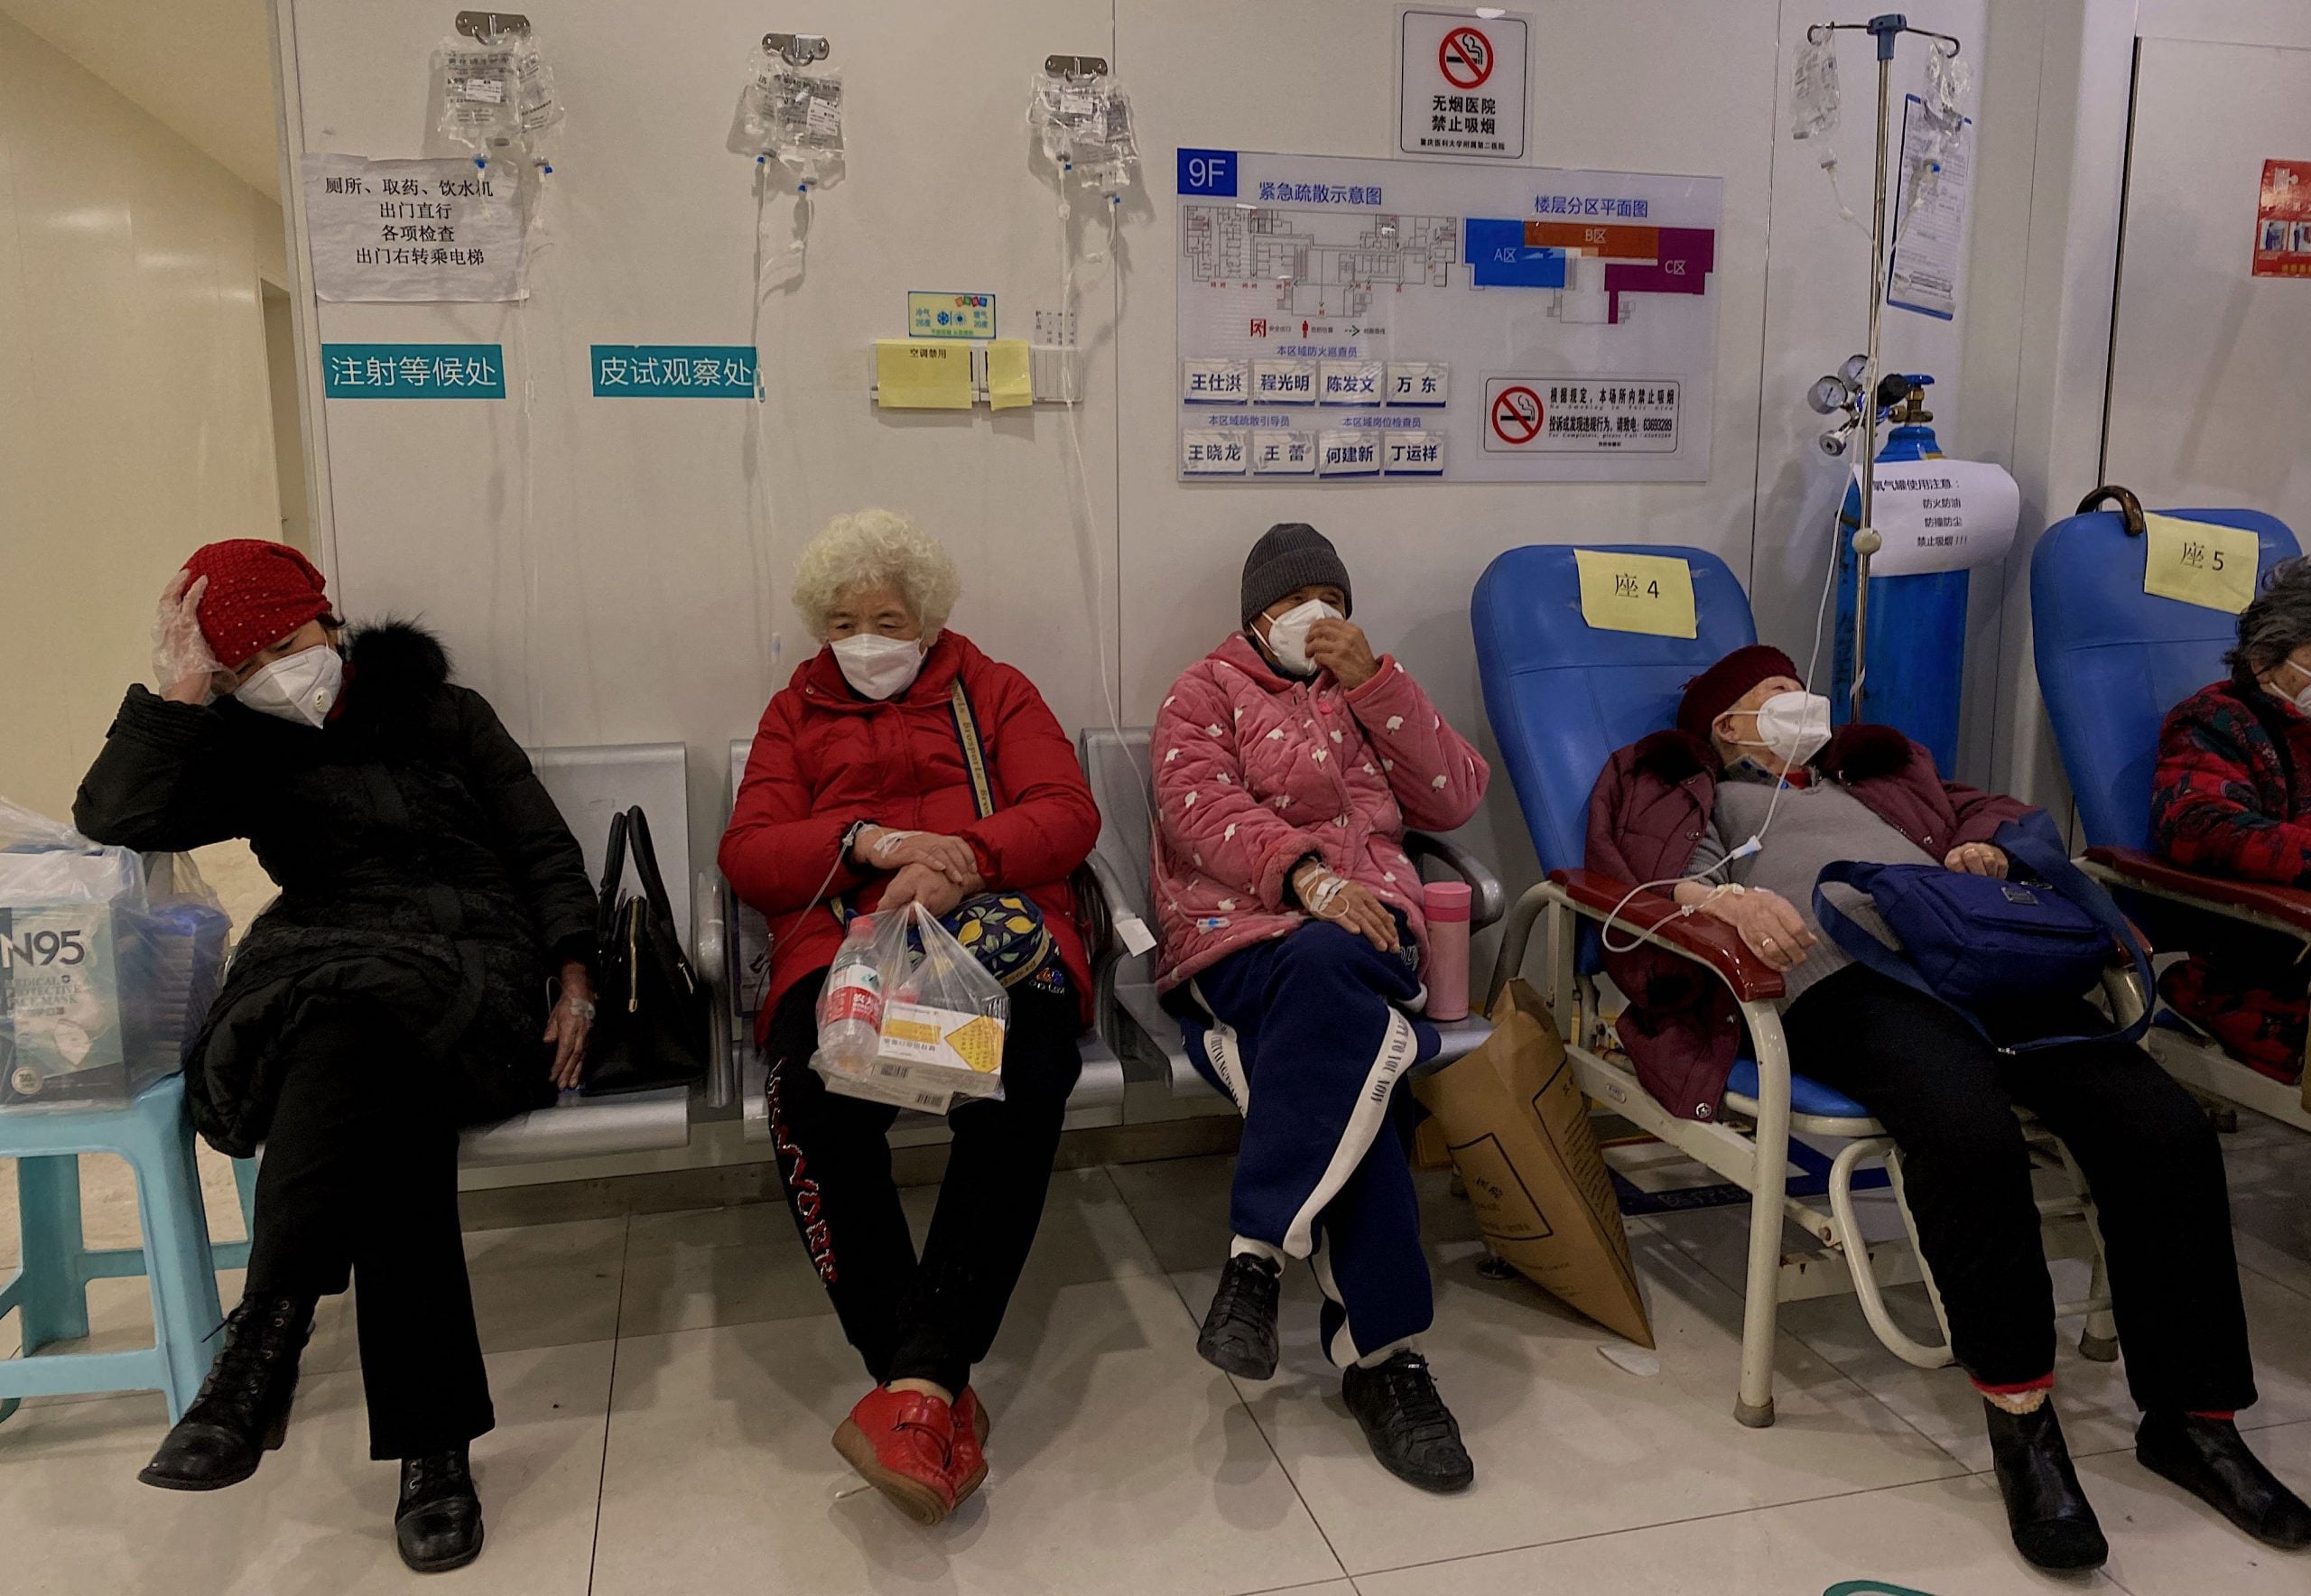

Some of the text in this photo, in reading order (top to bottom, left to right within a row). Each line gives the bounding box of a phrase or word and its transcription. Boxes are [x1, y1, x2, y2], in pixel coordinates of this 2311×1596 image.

[1432, 95, 1496, 115] 无烟医院
[1432, 115, 1495, 135] 禁止吸烟
[1188, 158, 1226, 188] 9F
[325, 176, 494, 199] 厕所、取药、饮水机
[1258, 181, 1383, 206] 紧急疏散示意图
[380, 201, 452, 220] 出门直行
[1535, 195, 1649, 218] 楼层分区平面图
[381, 224, 456, 243] 各项检查
[1585, 228, 1606, 244] B区
[356, 247, 485, 266] 出门右转乘电梯
[1494, 247, 1516, 263] A区
[1665, 260, 1685, 275] C区
[909, 348, 947, 359] 空调禁用
[330, 355, 497, 387] 注射等候处
[599, 356, 753, 387] 皮试观察处
[1192, 373, 1242, 393] 王仕洪
[1260, 374, 1310, 392] 程光明
[1326, 376, 1375, 393] 陈发文
[1188, 444, 1241, 462] 王晓龙
[1326, 445, 1374, 464] 何建新
[1390, 445, 1438, 462] 丁运祥
[1922, 497, 1962, 510] 防火防油
[2180, 542, 2224, 571] 座 5
[1615, 573, 1660, 598] 座 4
[0, 930, 86, 969] N95
